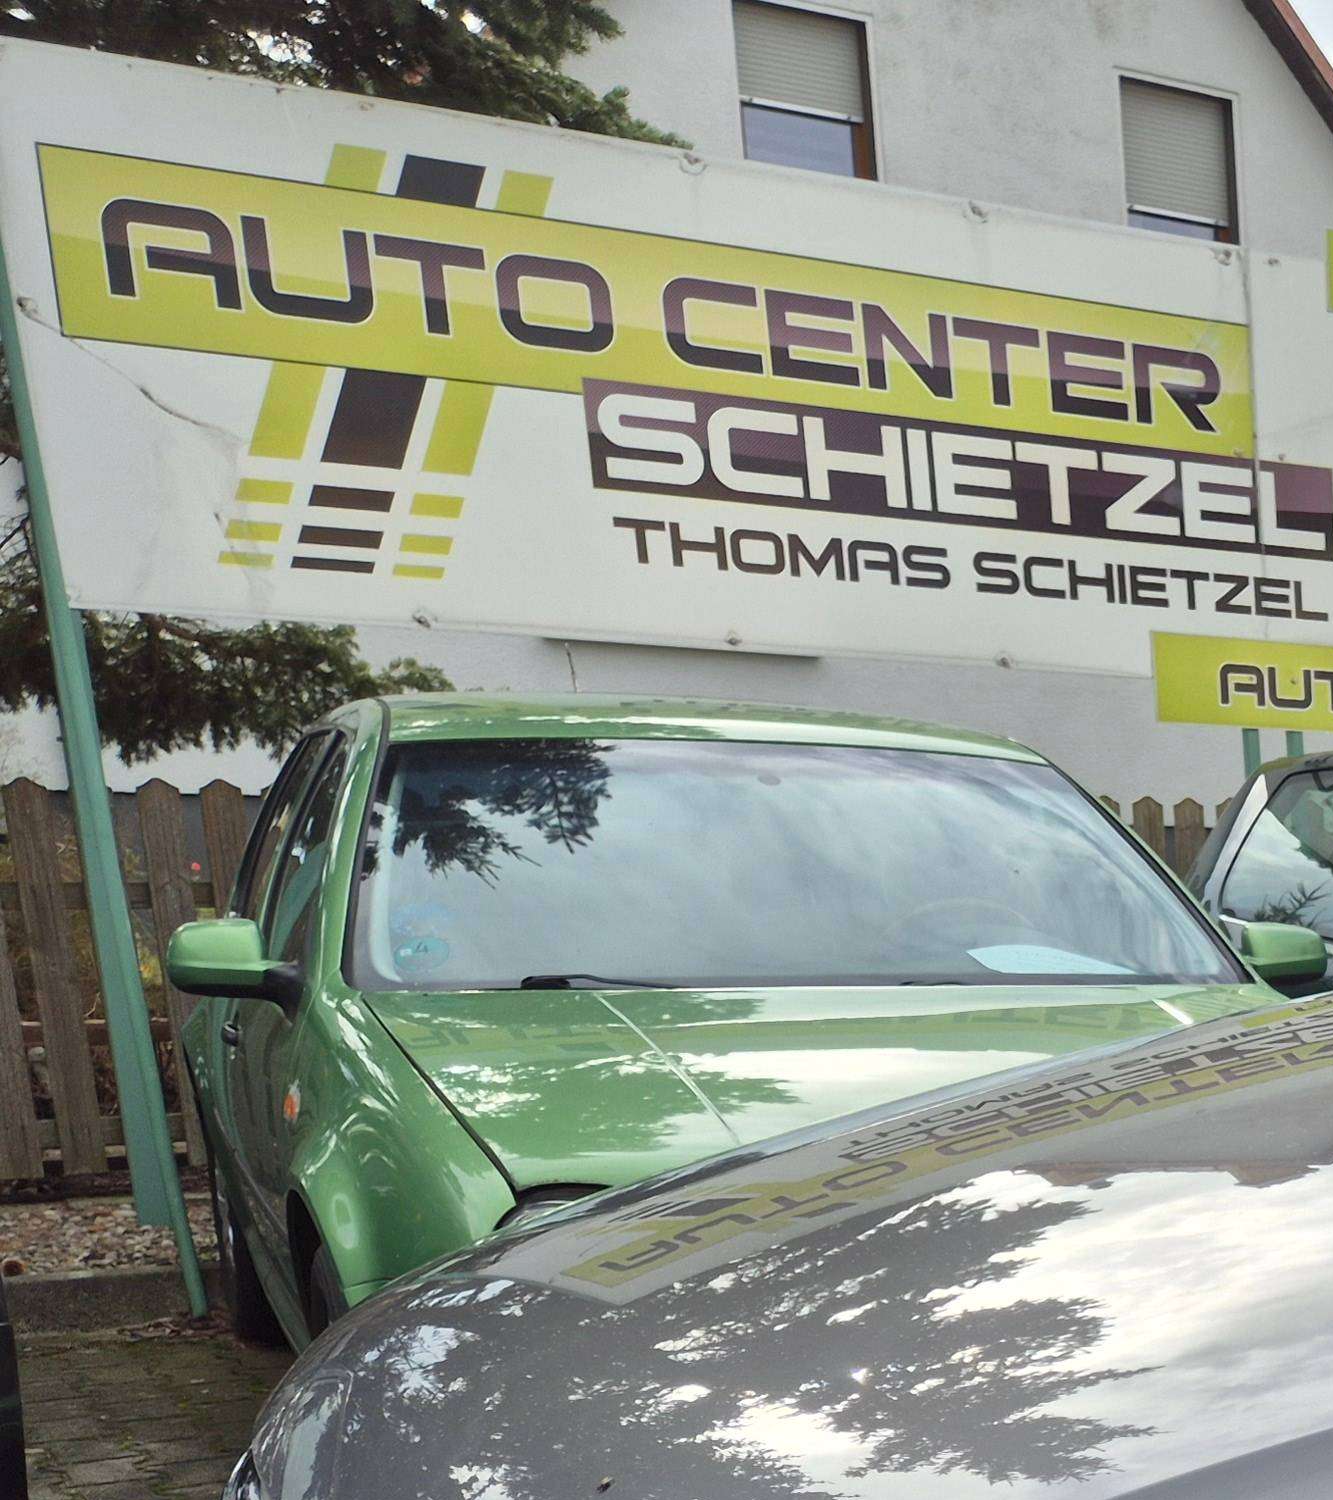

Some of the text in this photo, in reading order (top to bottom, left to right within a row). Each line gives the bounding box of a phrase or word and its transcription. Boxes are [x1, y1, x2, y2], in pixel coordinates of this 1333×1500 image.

[102, 198, 1221, 434] AUTO CENTER
[597, 394, 1327, 550] SCHIETZEL
[613, 517, 1328, 621] THOMAS SCHIETZEL
